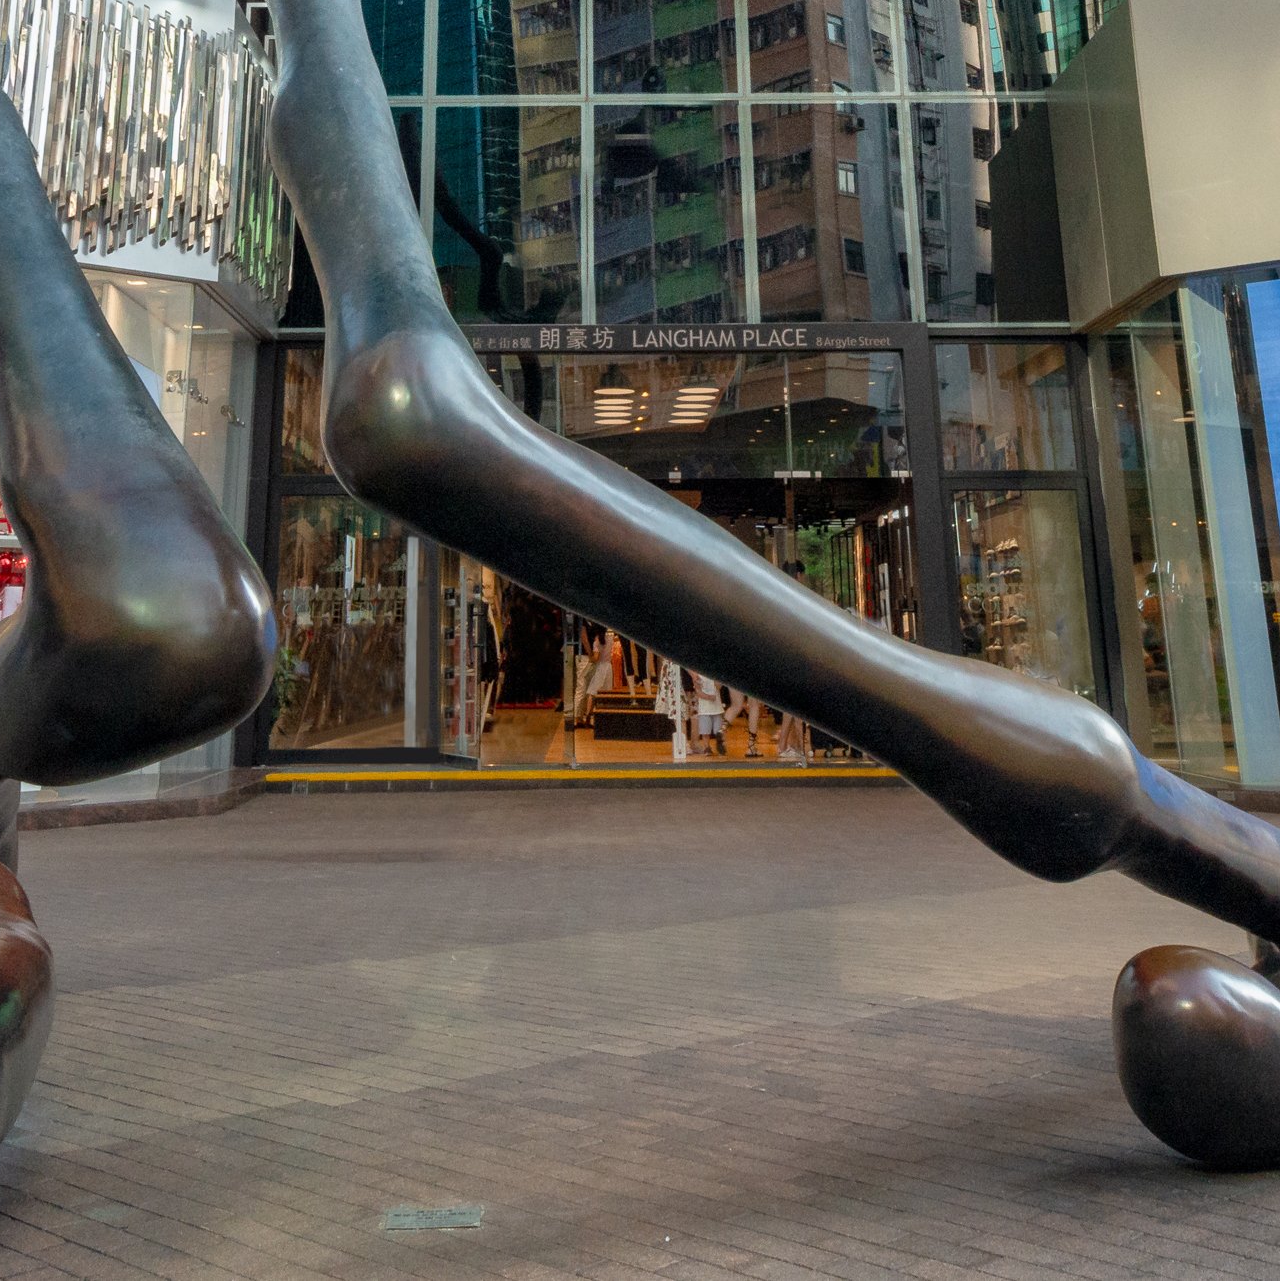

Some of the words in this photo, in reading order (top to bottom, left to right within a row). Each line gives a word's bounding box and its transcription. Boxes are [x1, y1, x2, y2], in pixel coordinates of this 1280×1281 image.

[539, 327, 615, 350] 朗豪坊
[632, 329, 736, 348] LANGHAM
[743, 328, 807, 348] PLACE
[816, 336, 823, 347] 8
[823, 336, 857, 349] Argyle
[858, 335, 891, 347] Street
